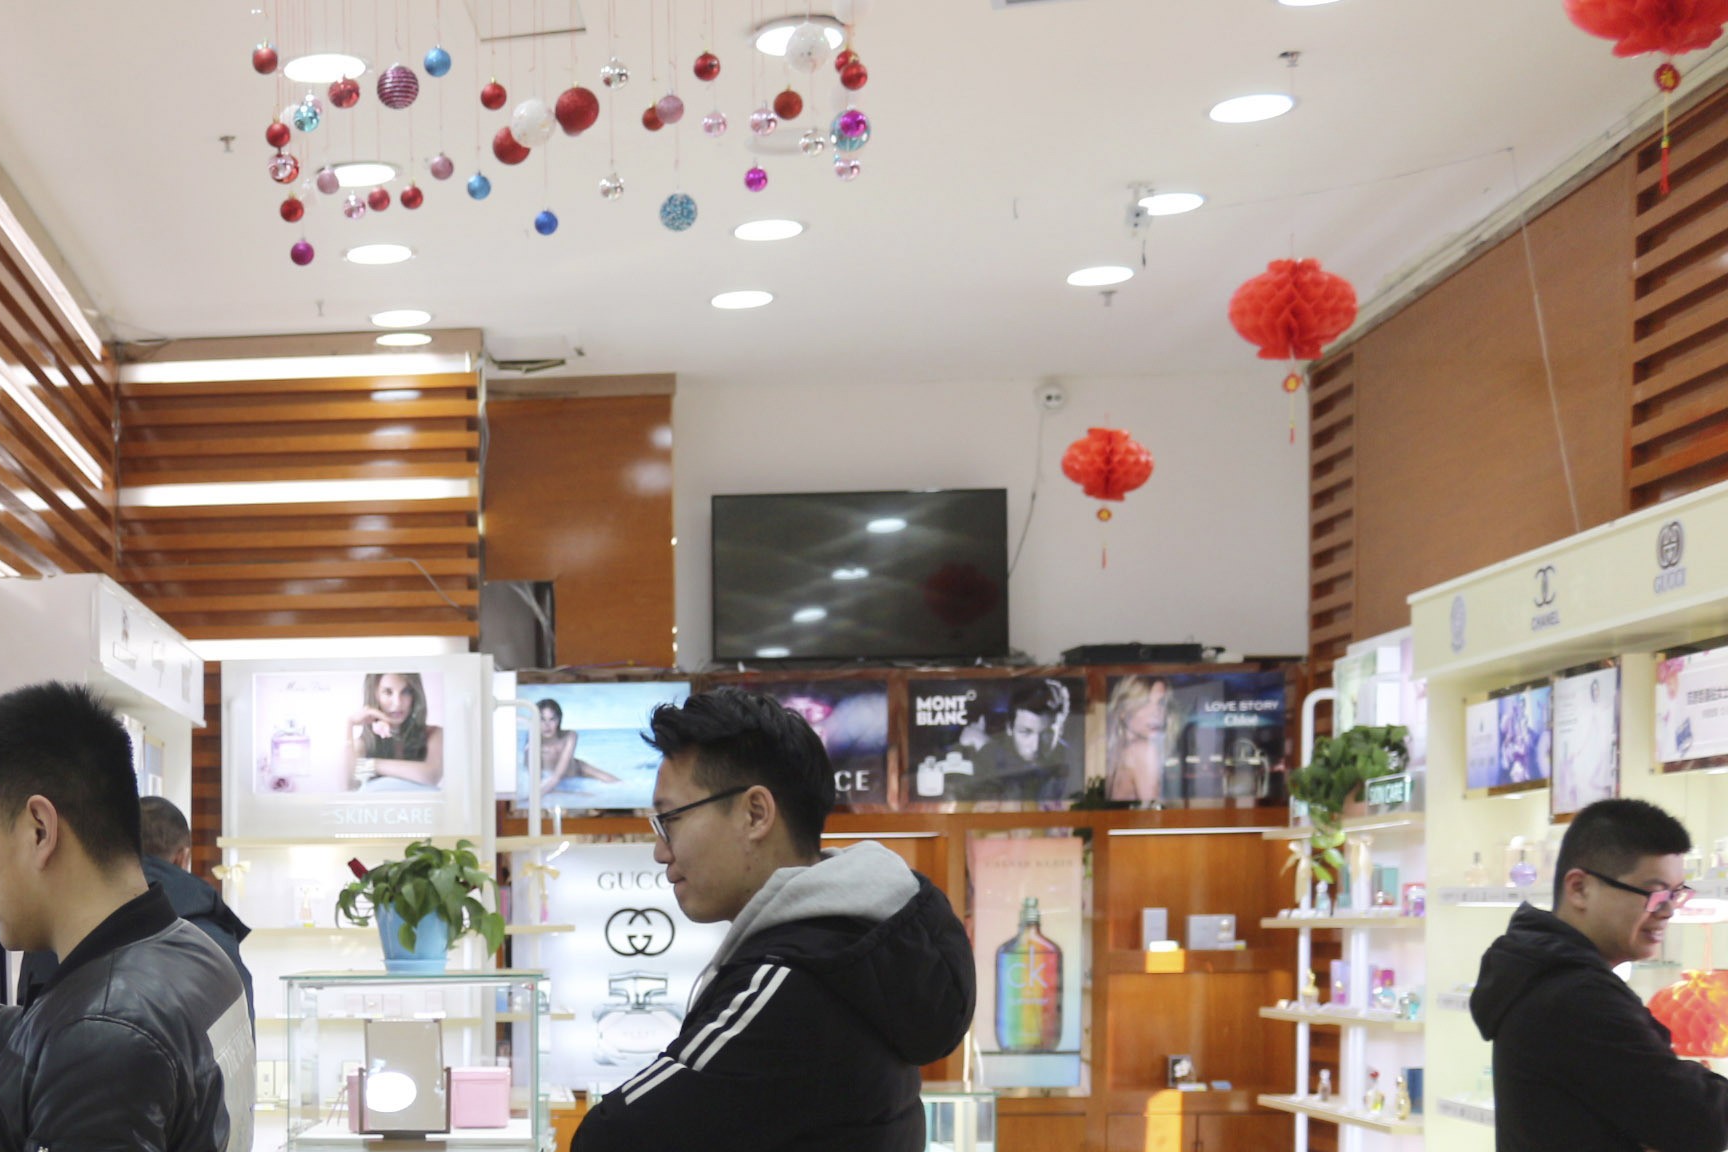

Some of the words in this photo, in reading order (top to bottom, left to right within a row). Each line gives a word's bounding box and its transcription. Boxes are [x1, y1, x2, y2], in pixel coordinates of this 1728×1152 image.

[916, 696, 968, 711] MONT
[1204, 700, 1236, 712] LOVE
[1238, 700, 1279, 711] STORY
[916, 711, 968, 726] BLANC
[833, 770, 871, 792] CE
[333, 807, 378, 825] SKIN
[383, 807, 433, 825] CARE
[597, 871, 673, 891] GUCC
[1006, 944, 1048, 988] ck
